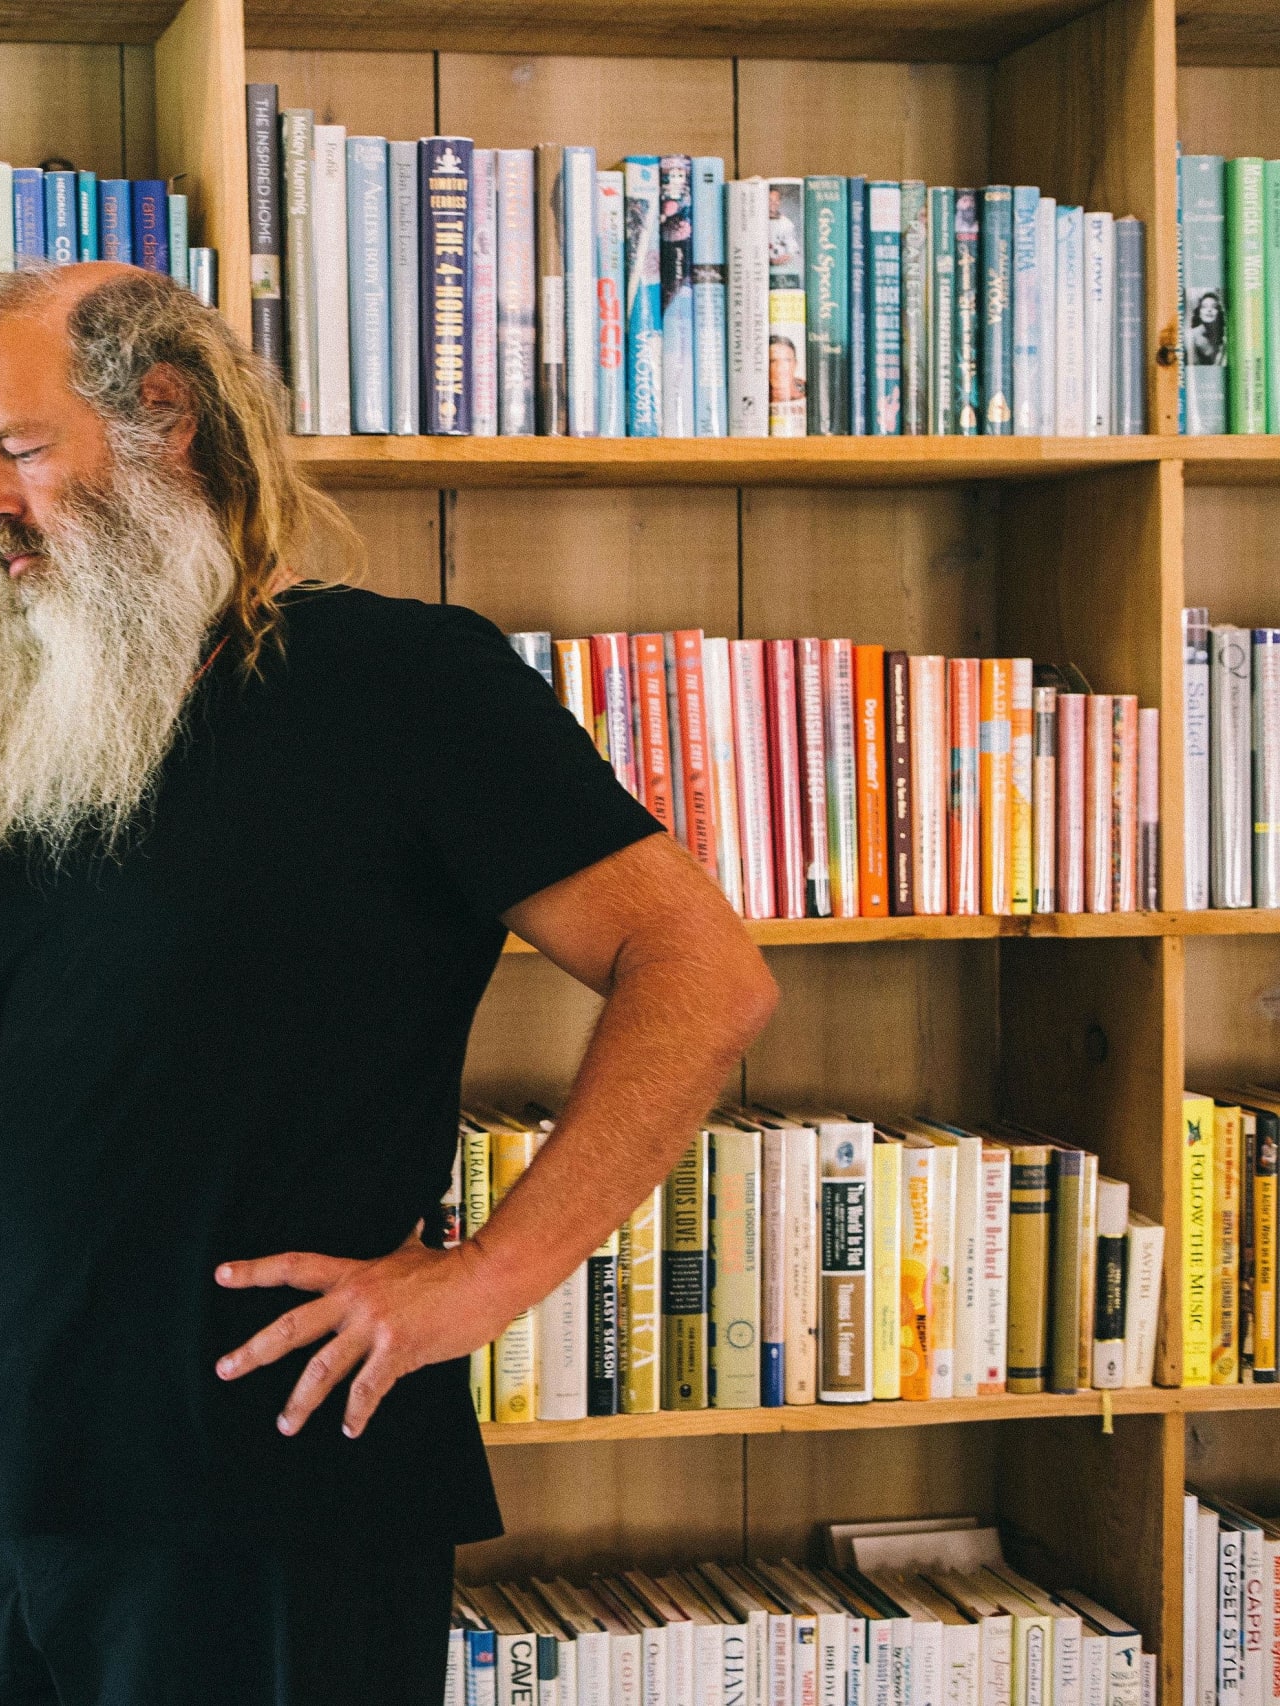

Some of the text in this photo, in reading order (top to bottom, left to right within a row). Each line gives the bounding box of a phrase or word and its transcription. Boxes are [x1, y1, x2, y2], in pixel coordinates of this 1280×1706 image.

[290, 116, 307, 155] Mickey
[56, 178, 66, 227] HENDRICKS
[256, 99, 272, 244] THE INSPIRED HOME
[291, 160, 308, 215] Muennig
[1243, 163, 1261, 235] Mavericks
[812, 208, 838, 319] God Speaks
[1016, 207, 1036, 272] TANTRA
[987, 276, 1002, 325] YOGA
[1244, 255, 1260, 291] Work
[435, 221, 464, 395] THE 4-HOUR BODY
[733, 247, 742, 374] ALEISTER CROWLEY
[647, 678, 664, 774] THE WRECKING CREW
[685, 673, 703, 770] THE WRECKING CREW
[803, 664, 820, 746] MAHARISHI
[863, 718, 876, 740] you
[865, 699, 877, 717] Do
[1186, 682, 1205, 757] Salted
[865, 742, 878, 790] matter?
[654, 795, 666, 819] KENT
[693, 791, 708, 863] KENT HARTMAN
[469, 1140, 484, 1186] VIRAL
[675, 1210, 697, 1243] LOVE
[721, 1173, 744, 1274] SUN SIGNS
[745, 1171, 756, 1272] Linda Goodman's
[846, 1183, 864, 1265] The World Is Flat
[966, 1238, 974, 1261] FINE
[1190, 1154, 1205, 1331] FOLLOW THE MUSIC
[603, 1262, 615, 1379] THE LAST SEASON
[837, 1284, 853, 1320] Thomas
[837, 1332, 853, 1376] Friedman
[1223, 1543, 1238, 1691] GYPSET STYLE
[1247, 1579, 1262, 1652] CAPRI
[511, 1641, 532, 1706] CAVE
[622, 1652, 633, 1692] GOD
[825, 1646, 835, 1706] BOB DYL
[1062, 1638, 1076, 1686] blink
